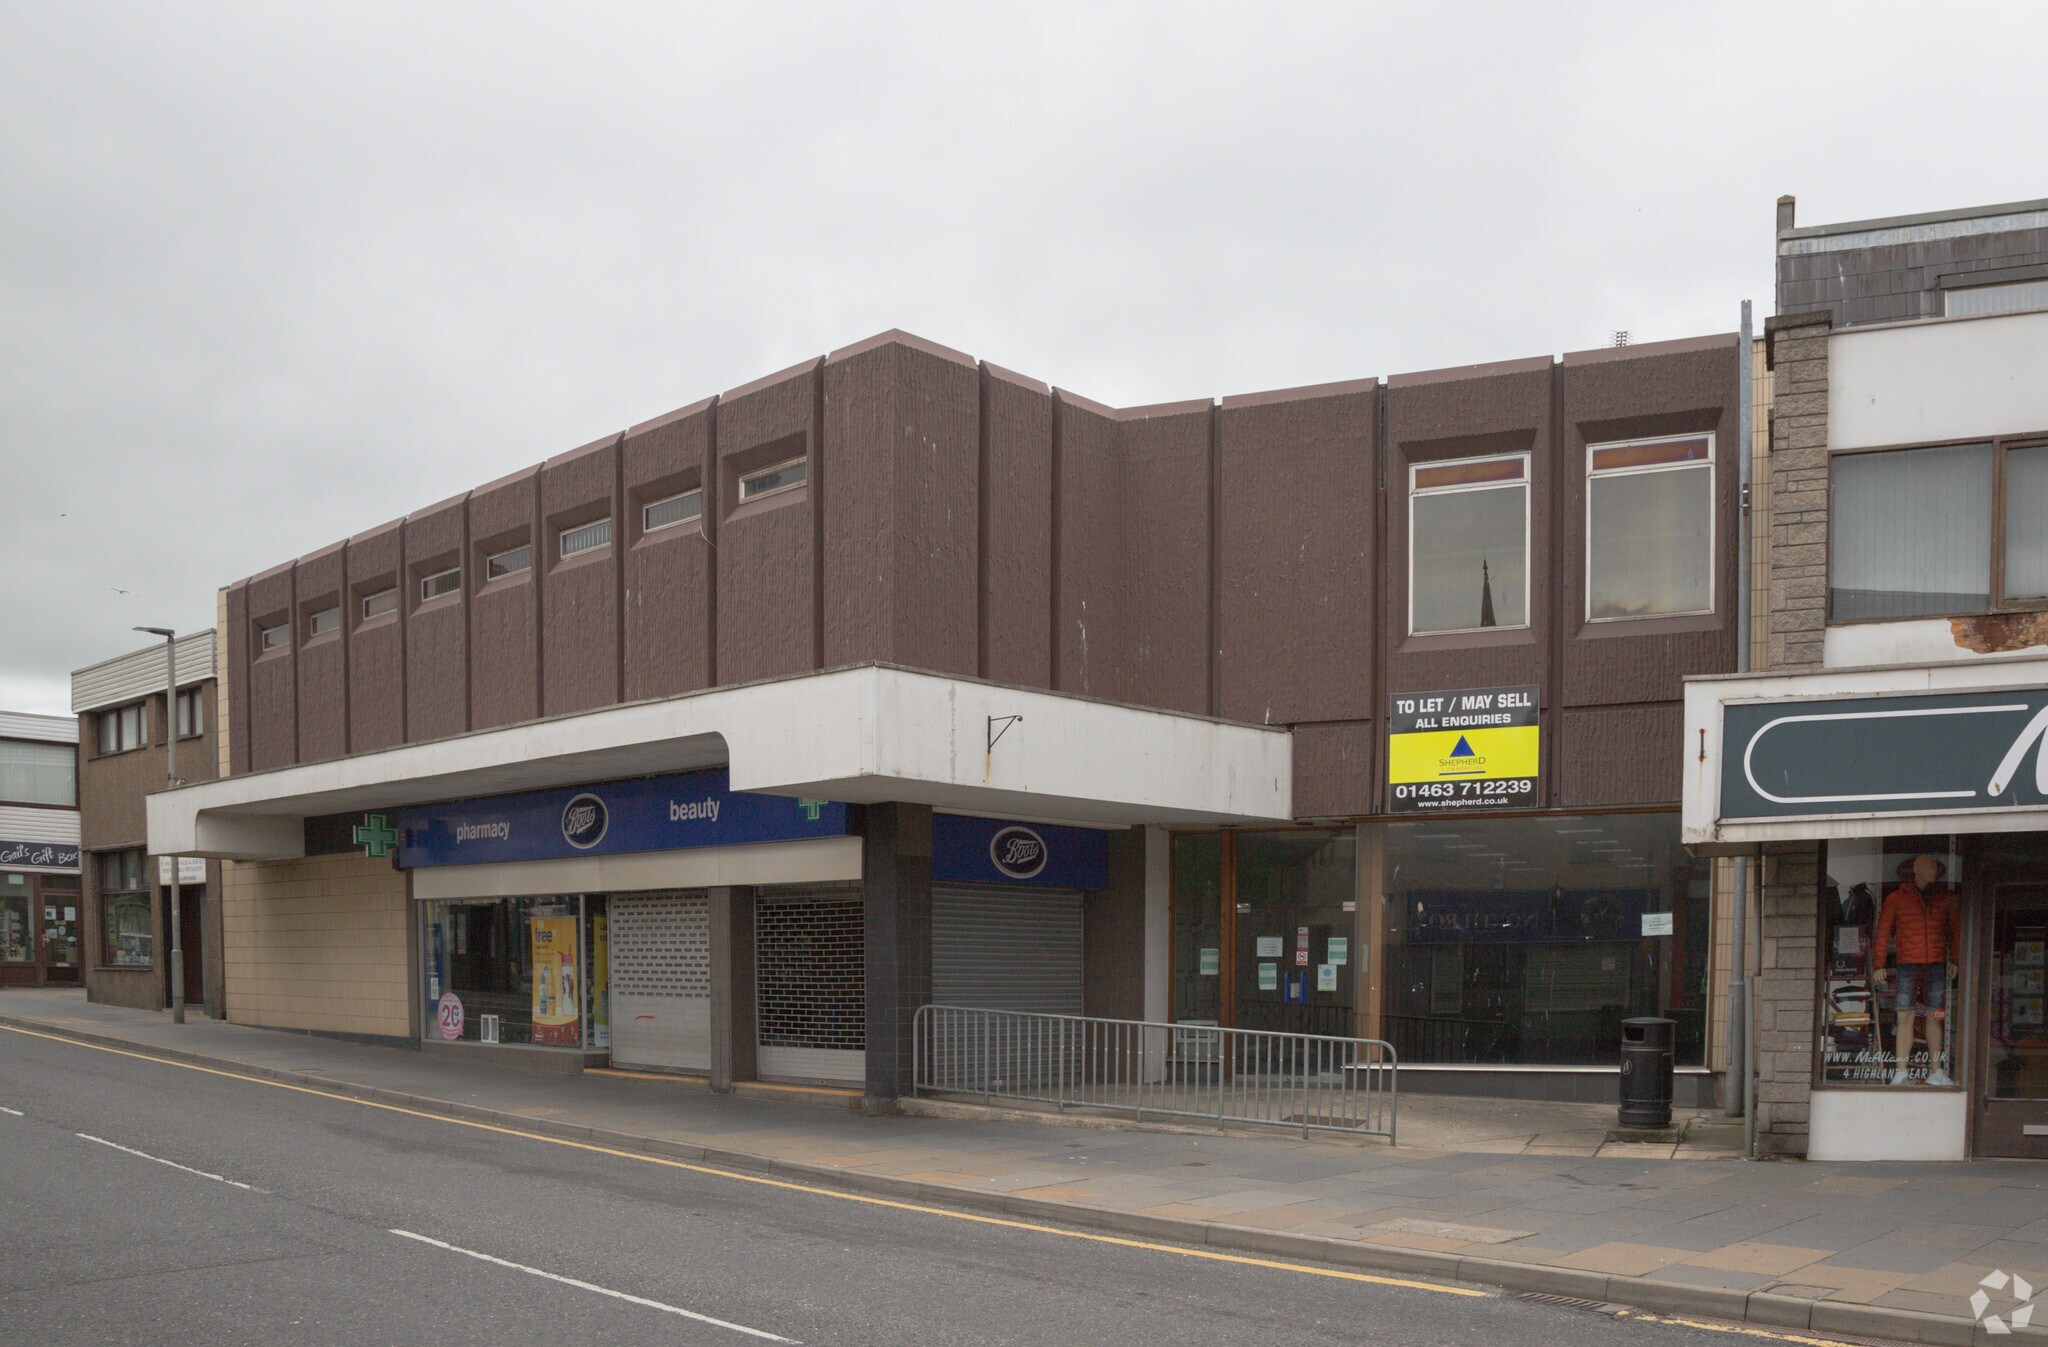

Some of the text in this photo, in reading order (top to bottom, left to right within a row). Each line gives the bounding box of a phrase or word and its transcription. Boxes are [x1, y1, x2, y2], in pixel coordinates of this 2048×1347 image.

[1397, 692, 1531, 714] TO LET / MAY SELL
[1415, 713, 1512, 729] ALL ENQUIRIES
[1441, 765, 1483, 773] COMMERCIAL
[1395, 779, 1532, 799] 01463 712239
[670, 797, 720, 822] beauty
[1417, 797, 1509, 808] www.shepherd.co.uk
[566, 806, 597, 835] Boots
[456, 821, 510, 844] pharmacy
[0, 844, 78, 864] Gail's Gift Box
[1002, 838, 1040, 865] Boots
[535, 928, 553, 943] free
